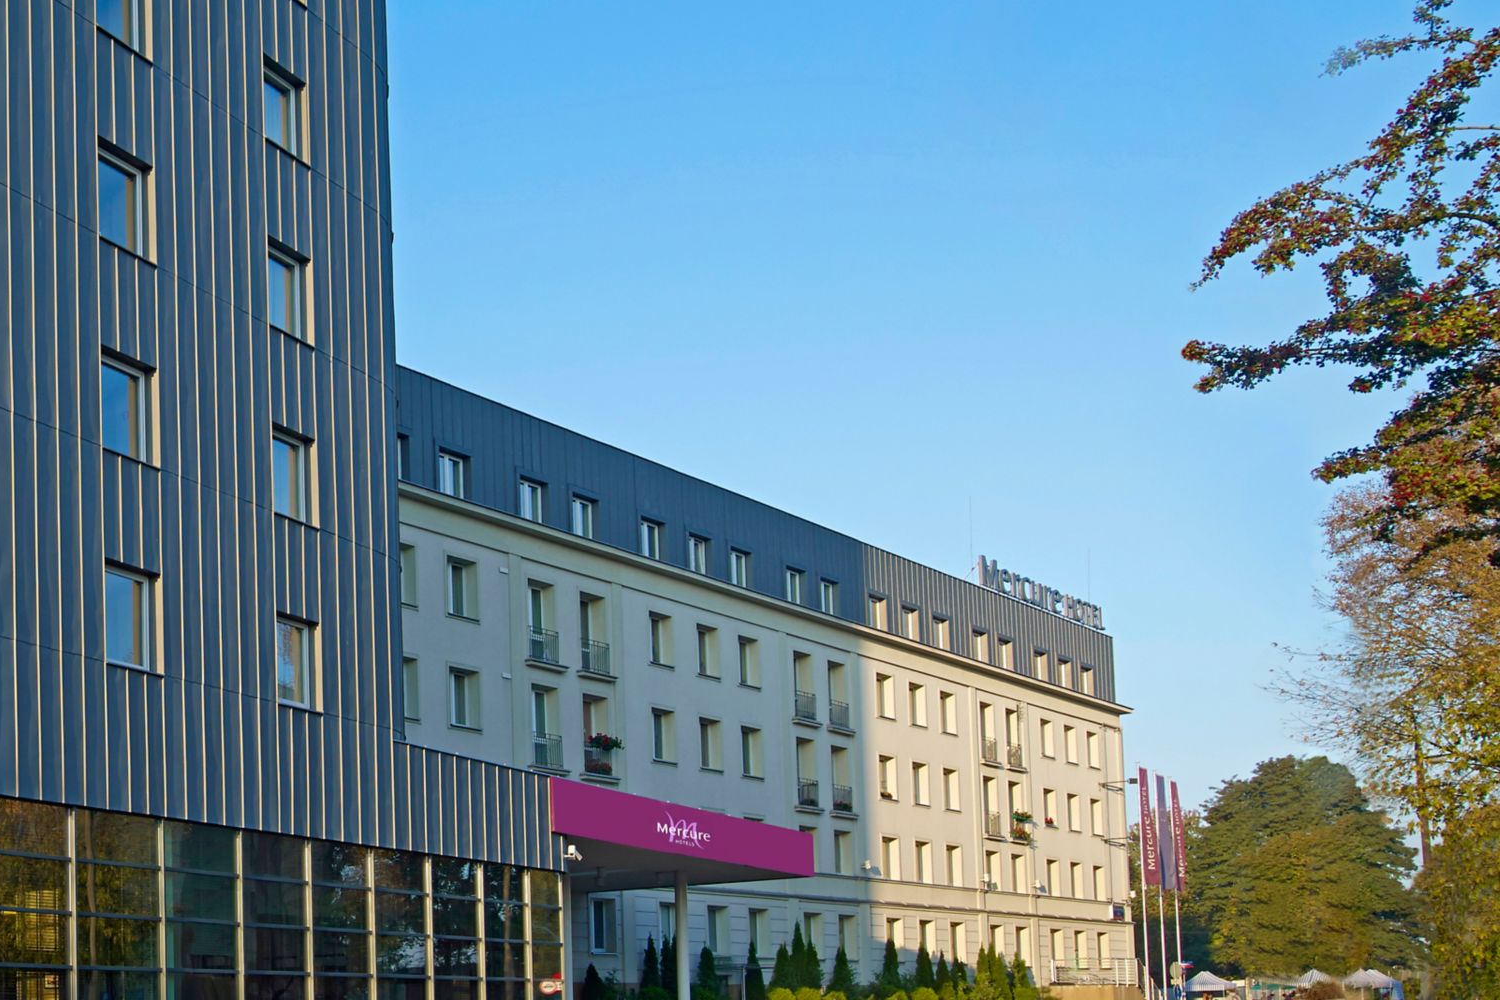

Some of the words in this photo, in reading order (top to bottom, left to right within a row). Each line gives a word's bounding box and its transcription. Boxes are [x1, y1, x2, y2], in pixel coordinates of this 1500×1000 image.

[978, 554, 1062, 614] Mercure
[656, 821, 711, 842] Mercure
[675, 839, 695, 848] HOTELS
[1145, 816, 1156, 870] Mercure
